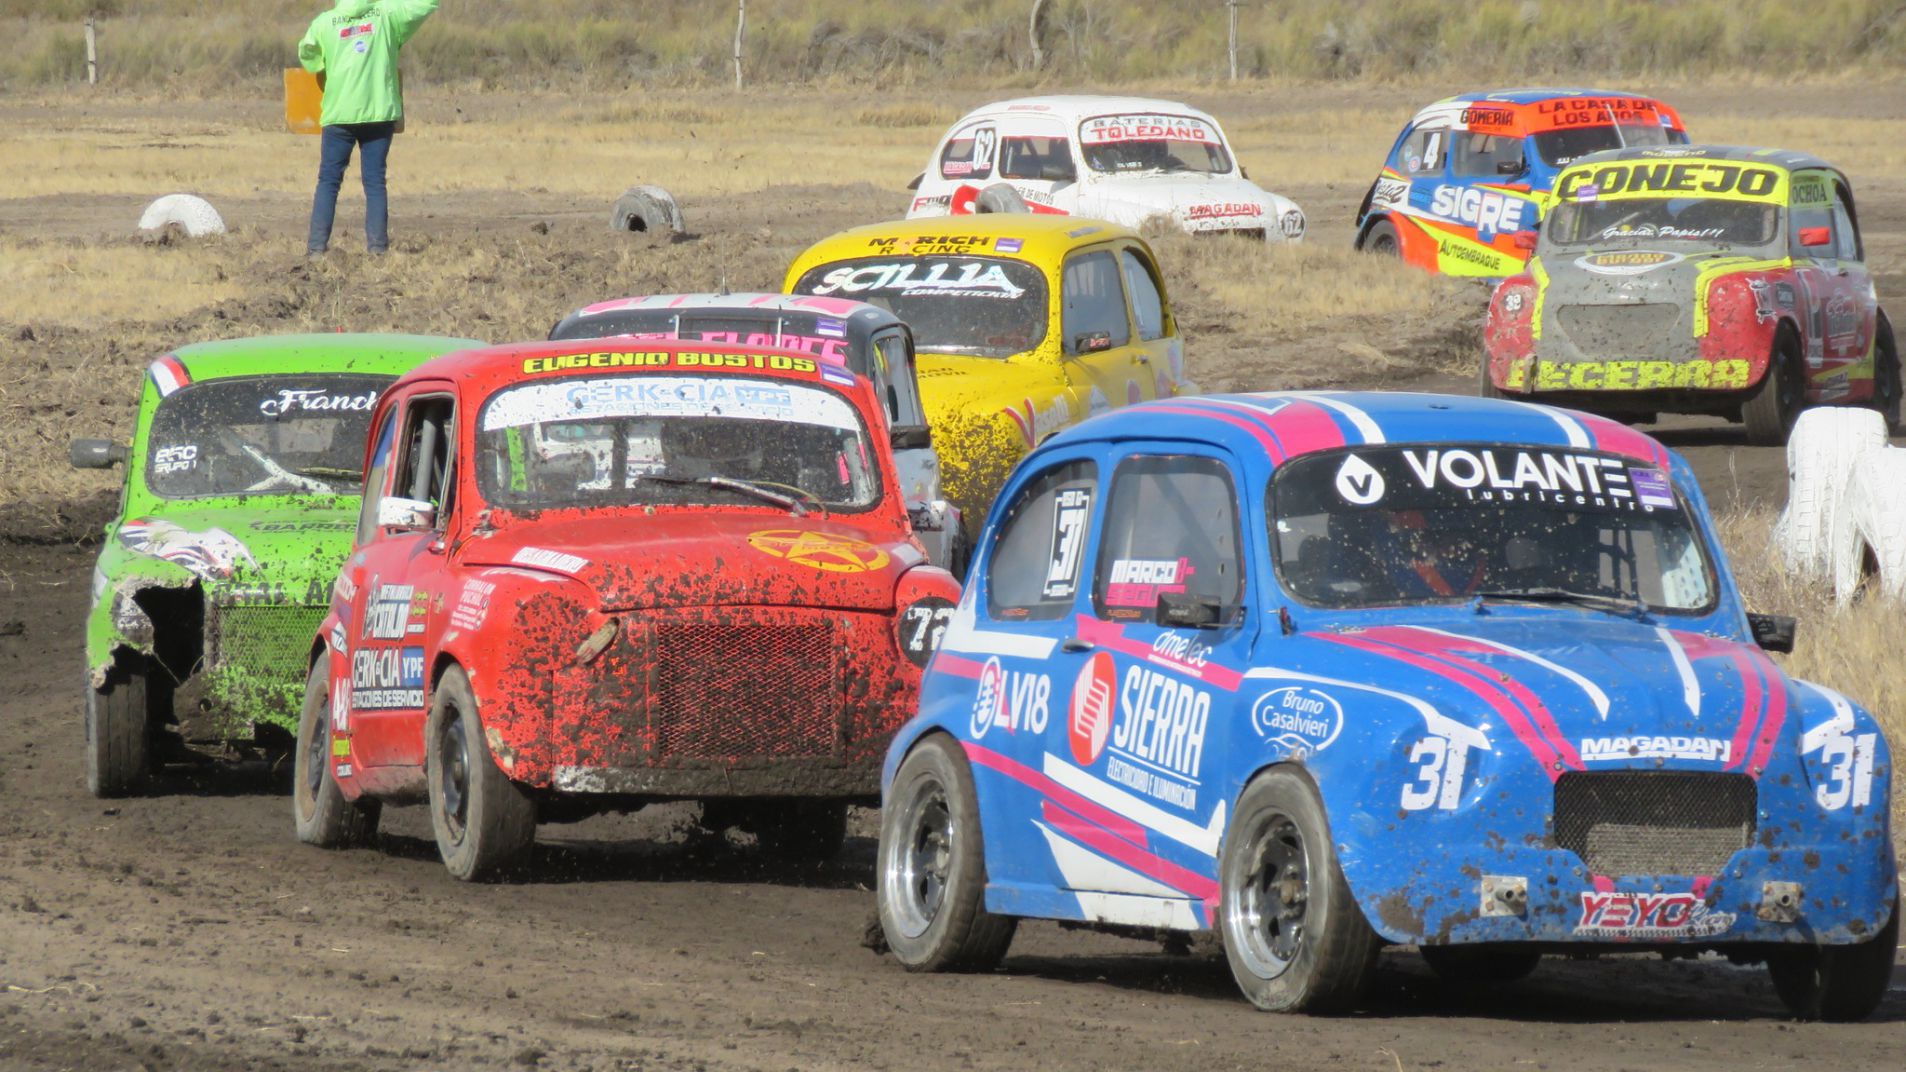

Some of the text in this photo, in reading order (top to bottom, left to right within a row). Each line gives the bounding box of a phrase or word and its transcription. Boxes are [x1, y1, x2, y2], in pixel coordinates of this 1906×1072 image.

[1094, 117, 1201, 128] BATERIAS
[1538, 101, 1566, 114] LA
[1571, 98, 1628, 111] CASA
[1553, 112, 1591, 126] LOS
[1090, 125, 1206, 140] TOLEDANO
[973, 129, 995, 171] 62
[1423, 132, 1441, 169] 4
[1557, 163, 1779, 198] CONEJO
[1792, 183, 1828, 204] OCHOA
[1431, 182, 1525, 234] SIGRE
[522, 351, 817, 375] EUGENIO BUSTOS
[1403, 448, 1632, 498] VOLANTE
[1466, 487, 1655, 513] lubricentro
[1049, 508, 1086, 583] 31
[1109, 559, 1178, 584] MARCO
[402, 656, 424, 679] YPF
[993, 669, 1051, 736] LV18
[1282, 690, 1325, 715] Bruno
[1112, 664, 1211, 778] SIERRA
[1262, 704, 1330, 738] Casalvieri
[1581, 735, 1732, 762] MAGADAN
[1400, 732, 1470, 810] 31
[1816, 732, 1878, 811] 31
[1580, 892, 1697, 929] YEYO
